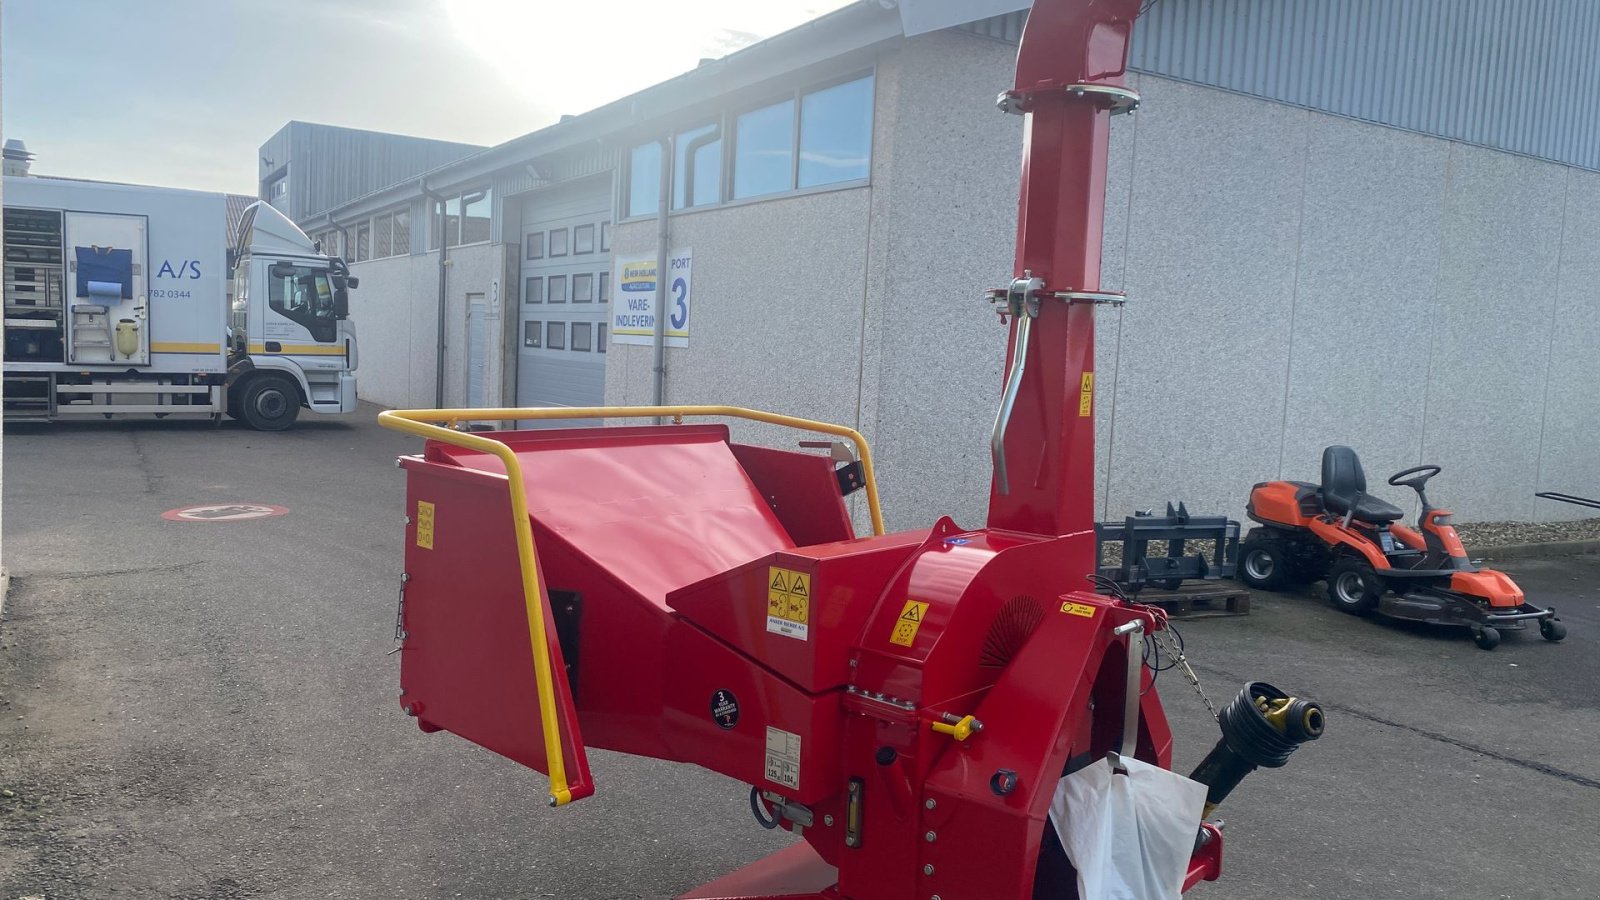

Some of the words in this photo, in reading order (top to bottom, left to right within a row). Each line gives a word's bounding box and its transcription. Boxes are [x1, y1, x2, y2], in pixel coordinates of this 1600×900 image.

[156, 259, 202, 280] A/S
[671, 257, 692, 269] PORT
[167, 290, 191, 298] 0344
[627, 298, 651, 311] VARE-
[670, 277, 687, 330] 3
[615, 314, 655, 328] INDLEVERIN
[717, 691, 725, 702] 3
